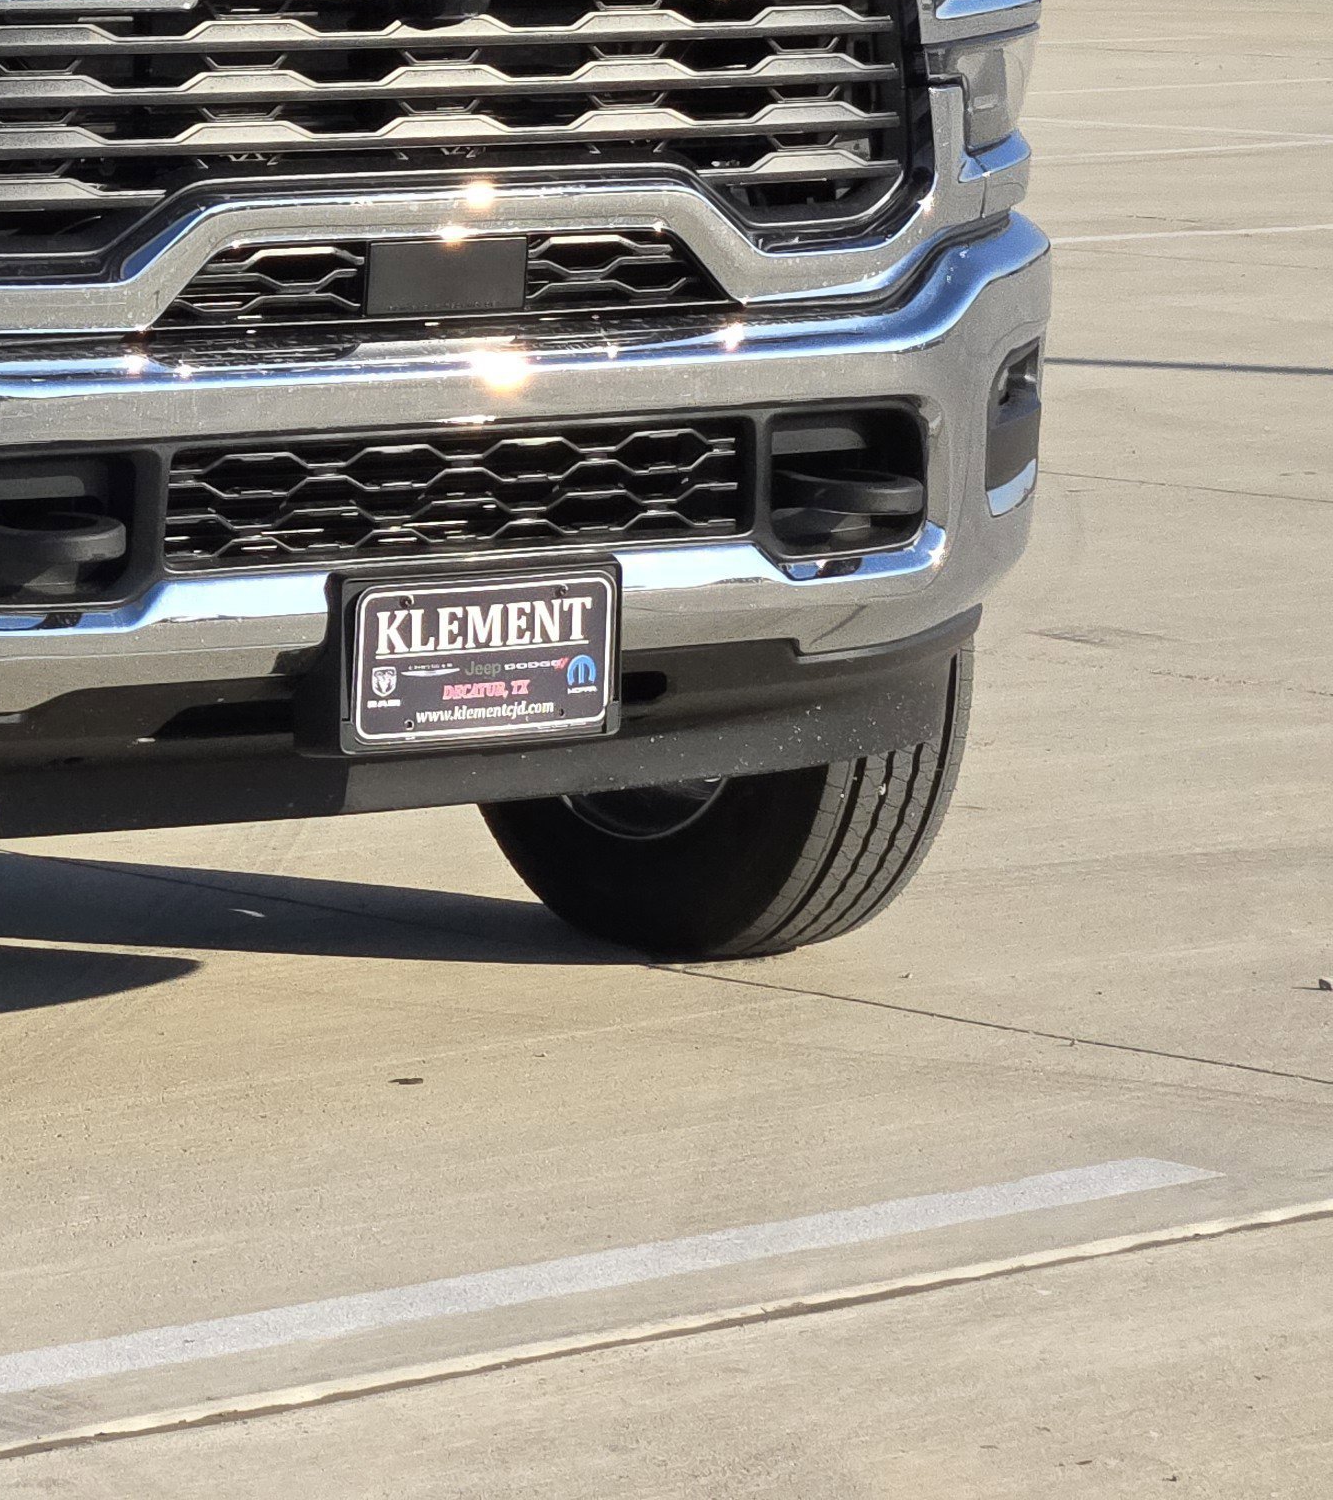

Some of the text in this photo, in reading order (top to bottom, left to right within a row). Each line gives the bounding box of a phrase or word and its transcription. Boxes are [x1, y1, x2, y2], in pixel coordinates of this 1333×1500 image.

[375, 597, 592, 654] KLEMENT
[465, 661, 501, 677] Jeep
[511, 680, 530, 695] TX
[416, 700, 554, 723] www.klementcjd.com
